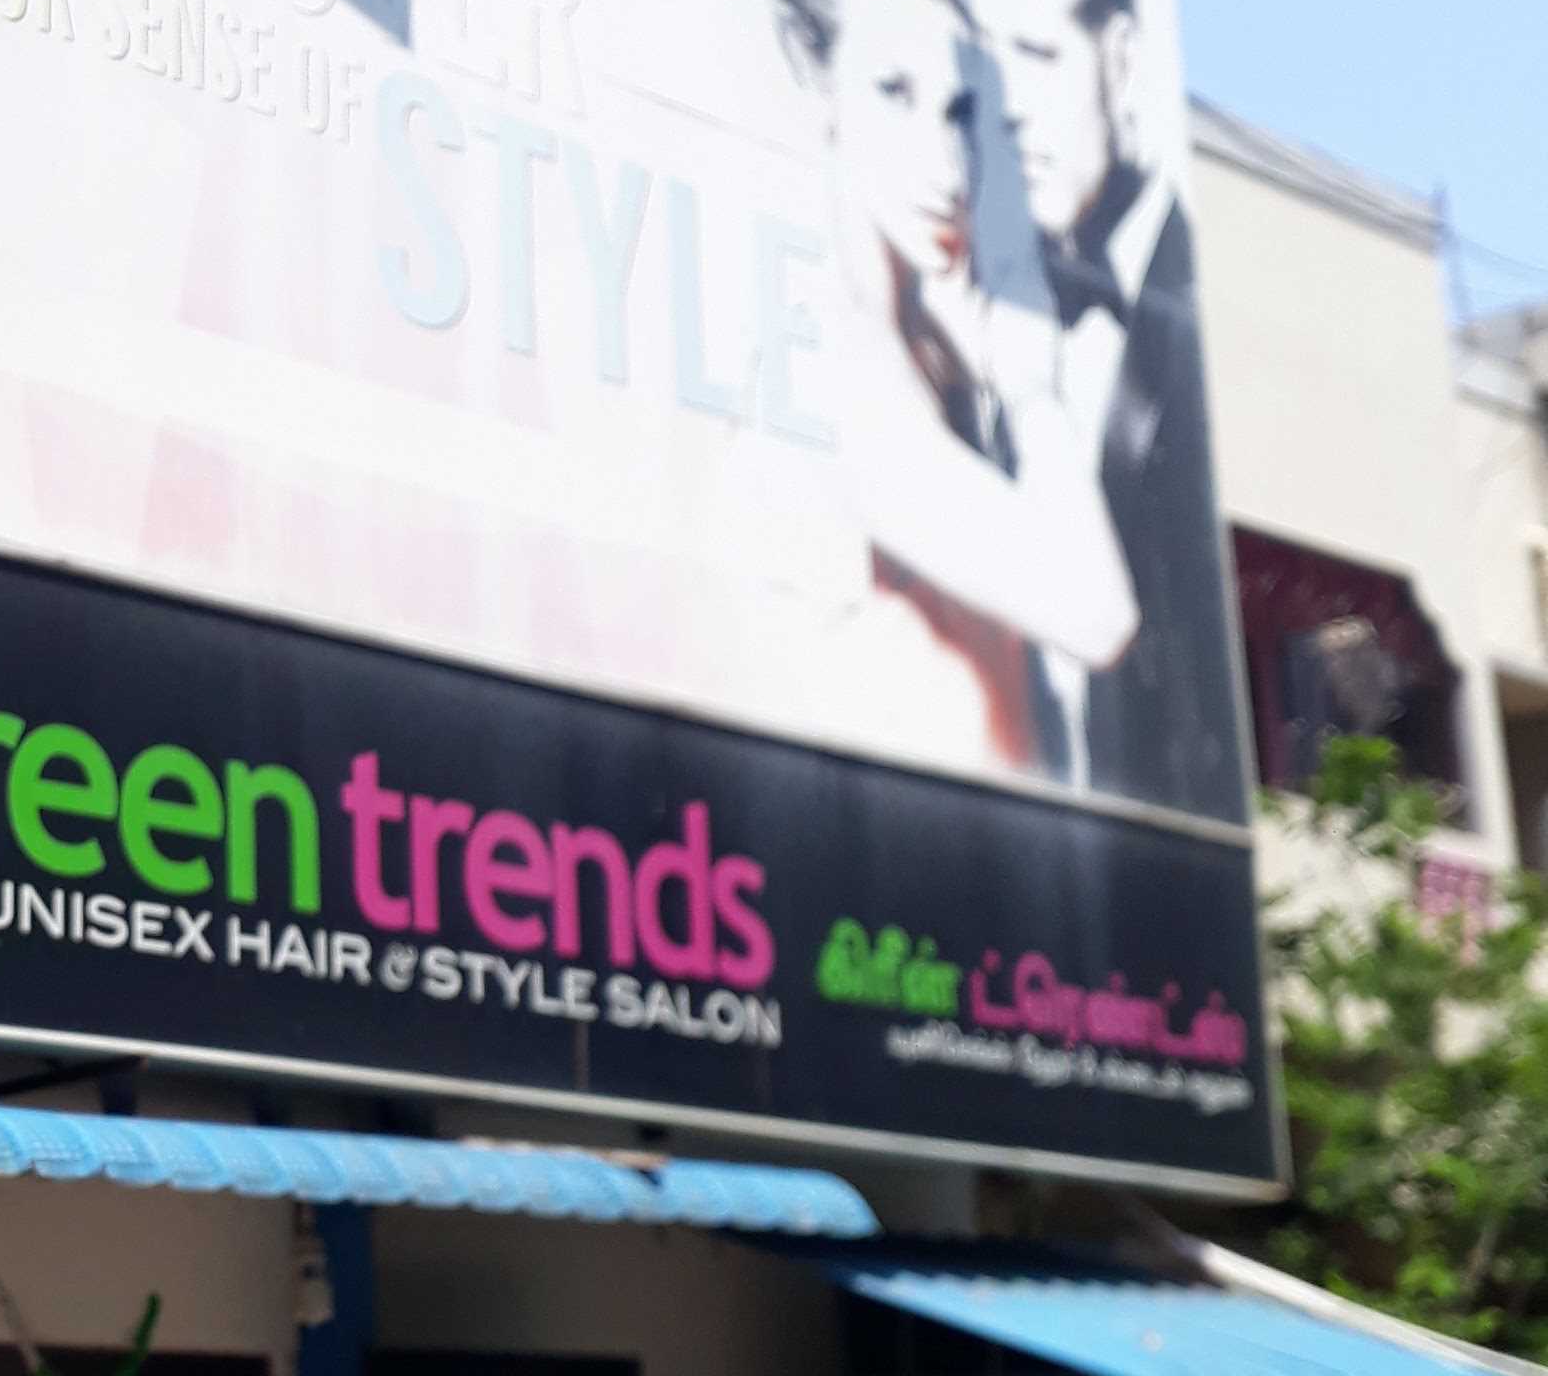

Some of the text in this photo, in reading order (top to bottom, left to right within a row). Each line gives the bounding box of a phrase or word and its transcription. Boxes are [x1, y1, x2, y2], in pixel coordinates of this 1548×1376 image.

[301, 45, 366, 145] OF
[375, 70, 838, 452] STYLE
[340, 749, 775, 990] trends
[225, 914, 373, 986] HAIR
[378, 941, 419, 993] &
[421, 945, 601, 1022] STYLE
[604, 971, 783, 1050] SALON
